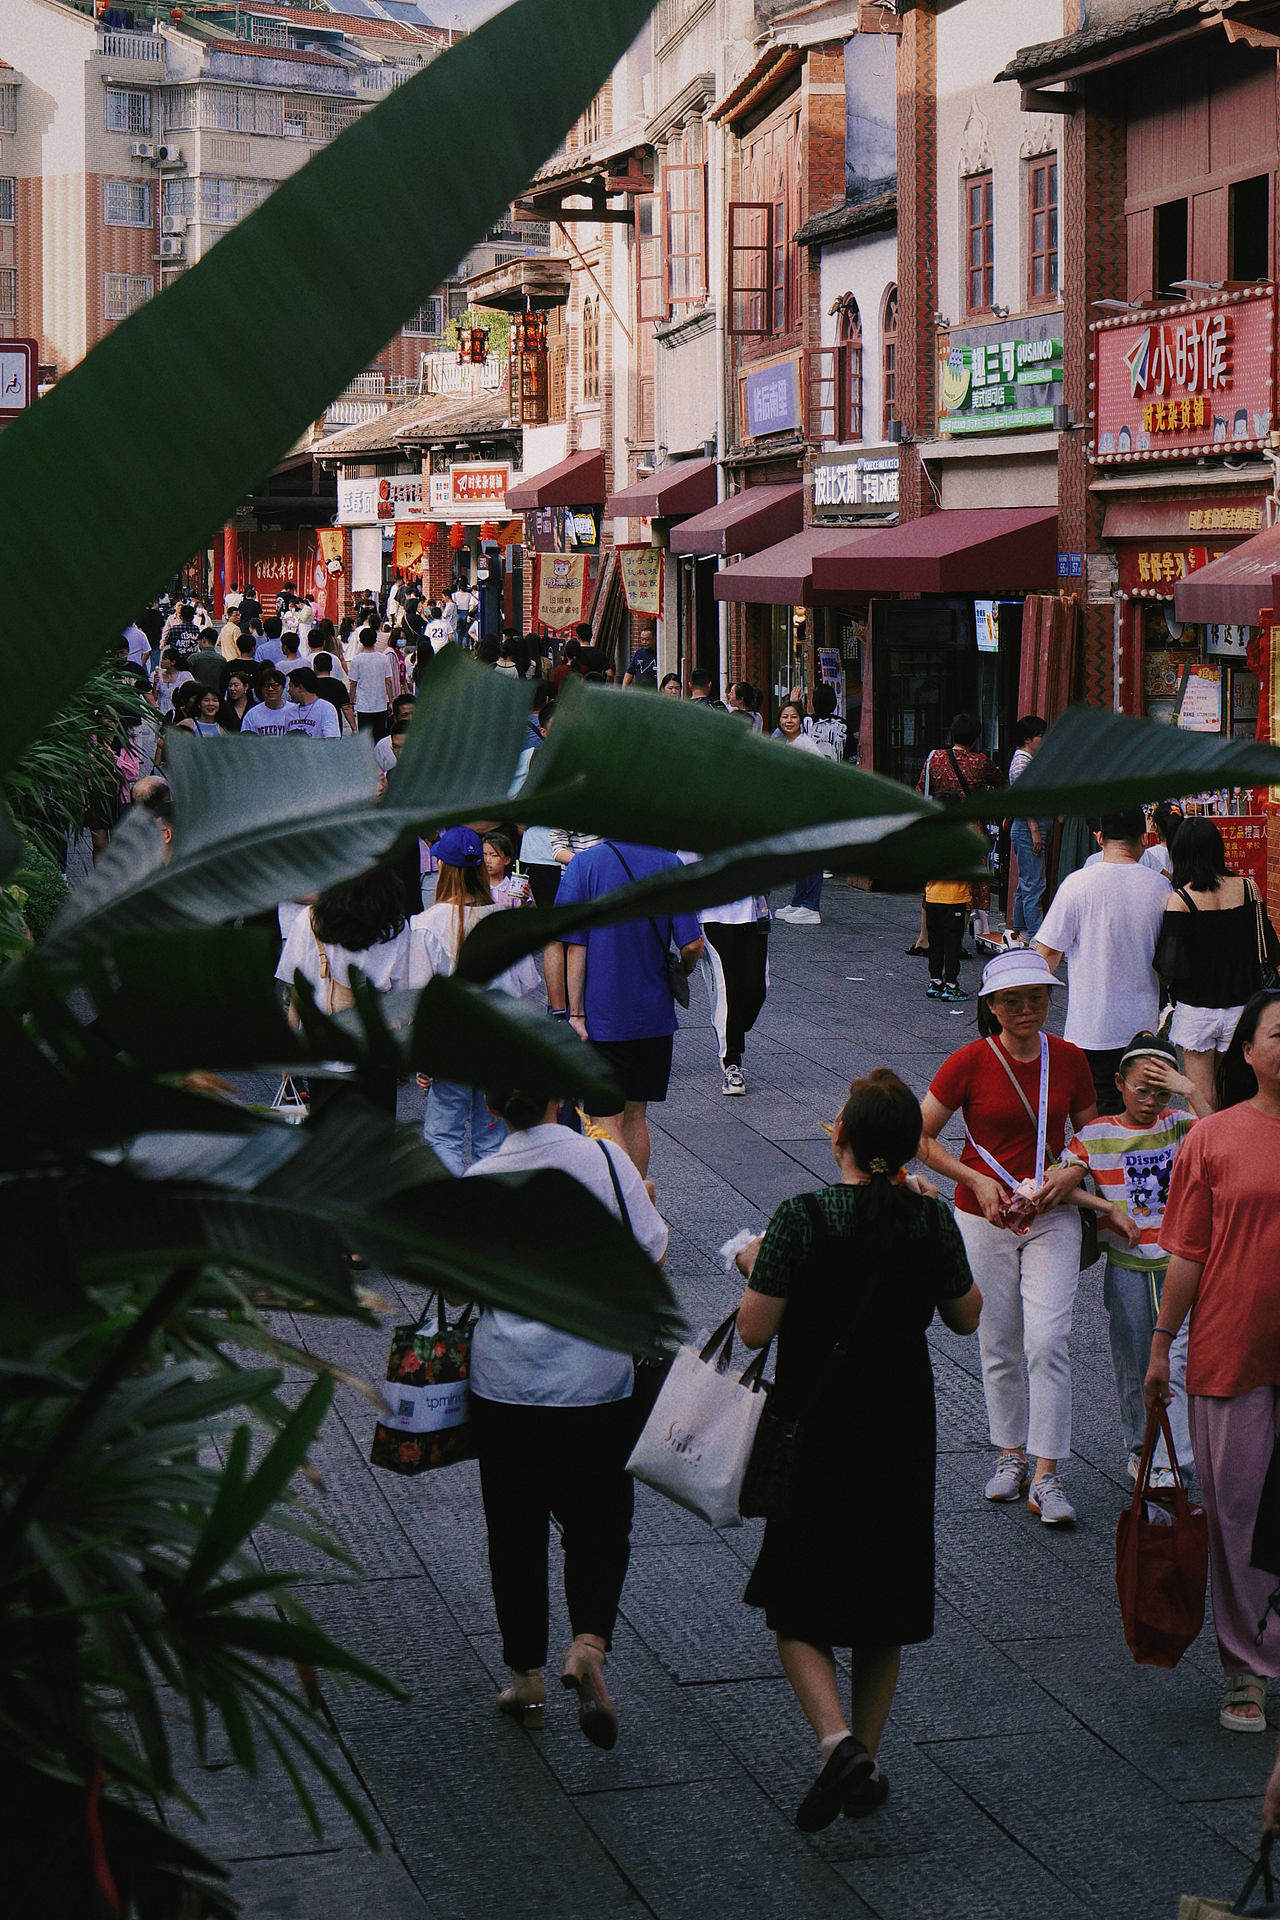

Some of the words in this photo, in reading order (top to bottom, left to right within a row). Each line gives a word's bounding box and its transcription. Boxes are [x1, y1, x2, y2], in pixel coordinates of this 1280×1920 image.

[1016, 339, 1053, 367] QUSANCO
[1151, 313, 1229, 396] 小时候
[254, 555, 295, 582] 百姓大舞台
[1138, 551, 1185, 583] 好好学习
[432, 627, 443, 638] 23
[1197, 667, 1221, 682] 招聘
[1217, 824, 1268, 840] 工艺品捏面人
[1126, 1148, 1172, 1166] Disney
